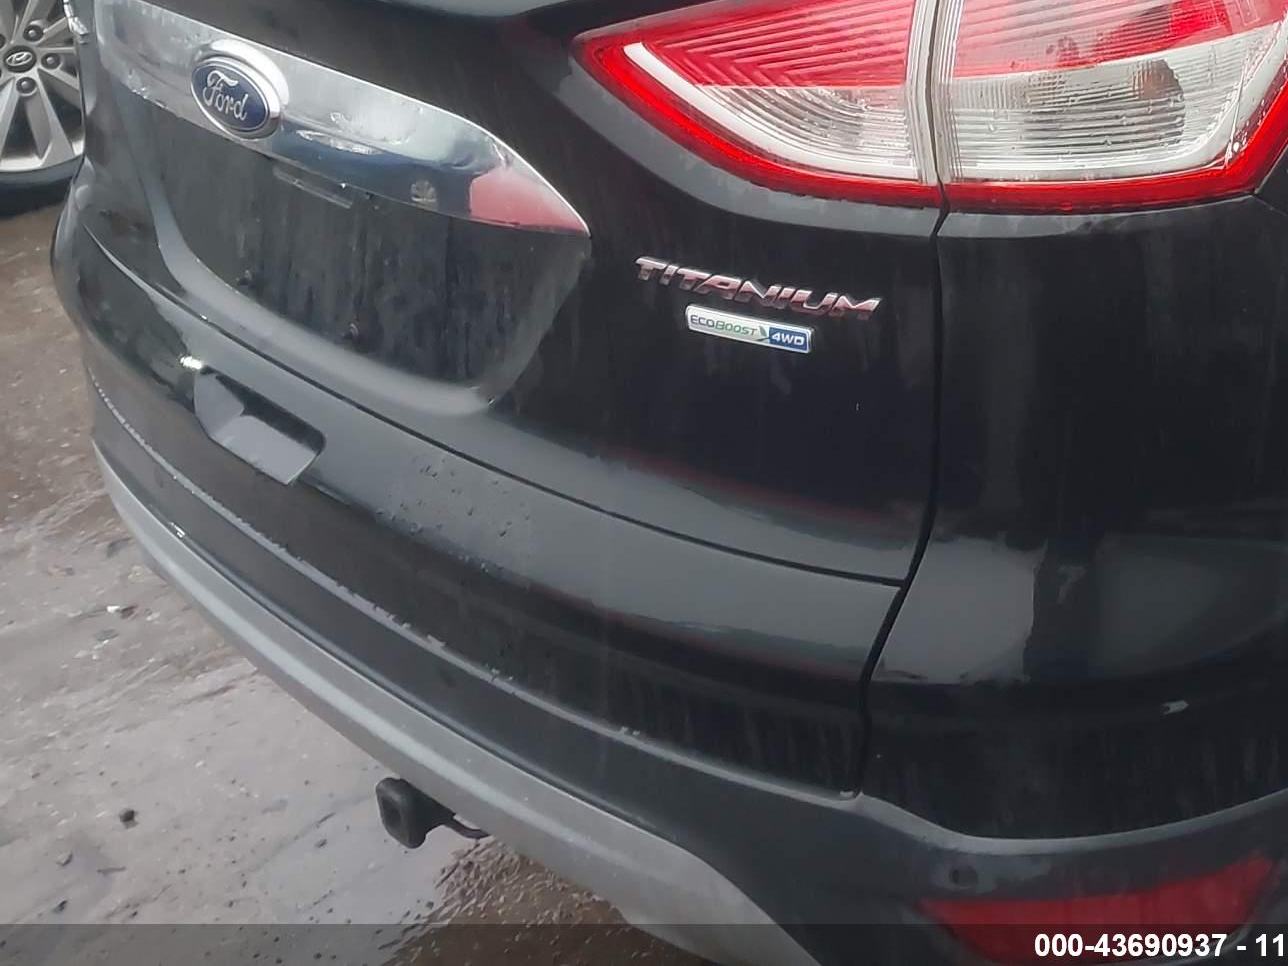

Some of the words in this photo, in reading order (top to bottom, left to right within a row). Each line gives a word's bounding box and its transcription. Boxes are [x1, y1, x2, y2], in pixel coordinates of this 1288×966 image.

[202, 70, 248, 121] Ford
[635, 256, 882, 320] TITANIUM
[771, 331, 805, 346] 4WD
